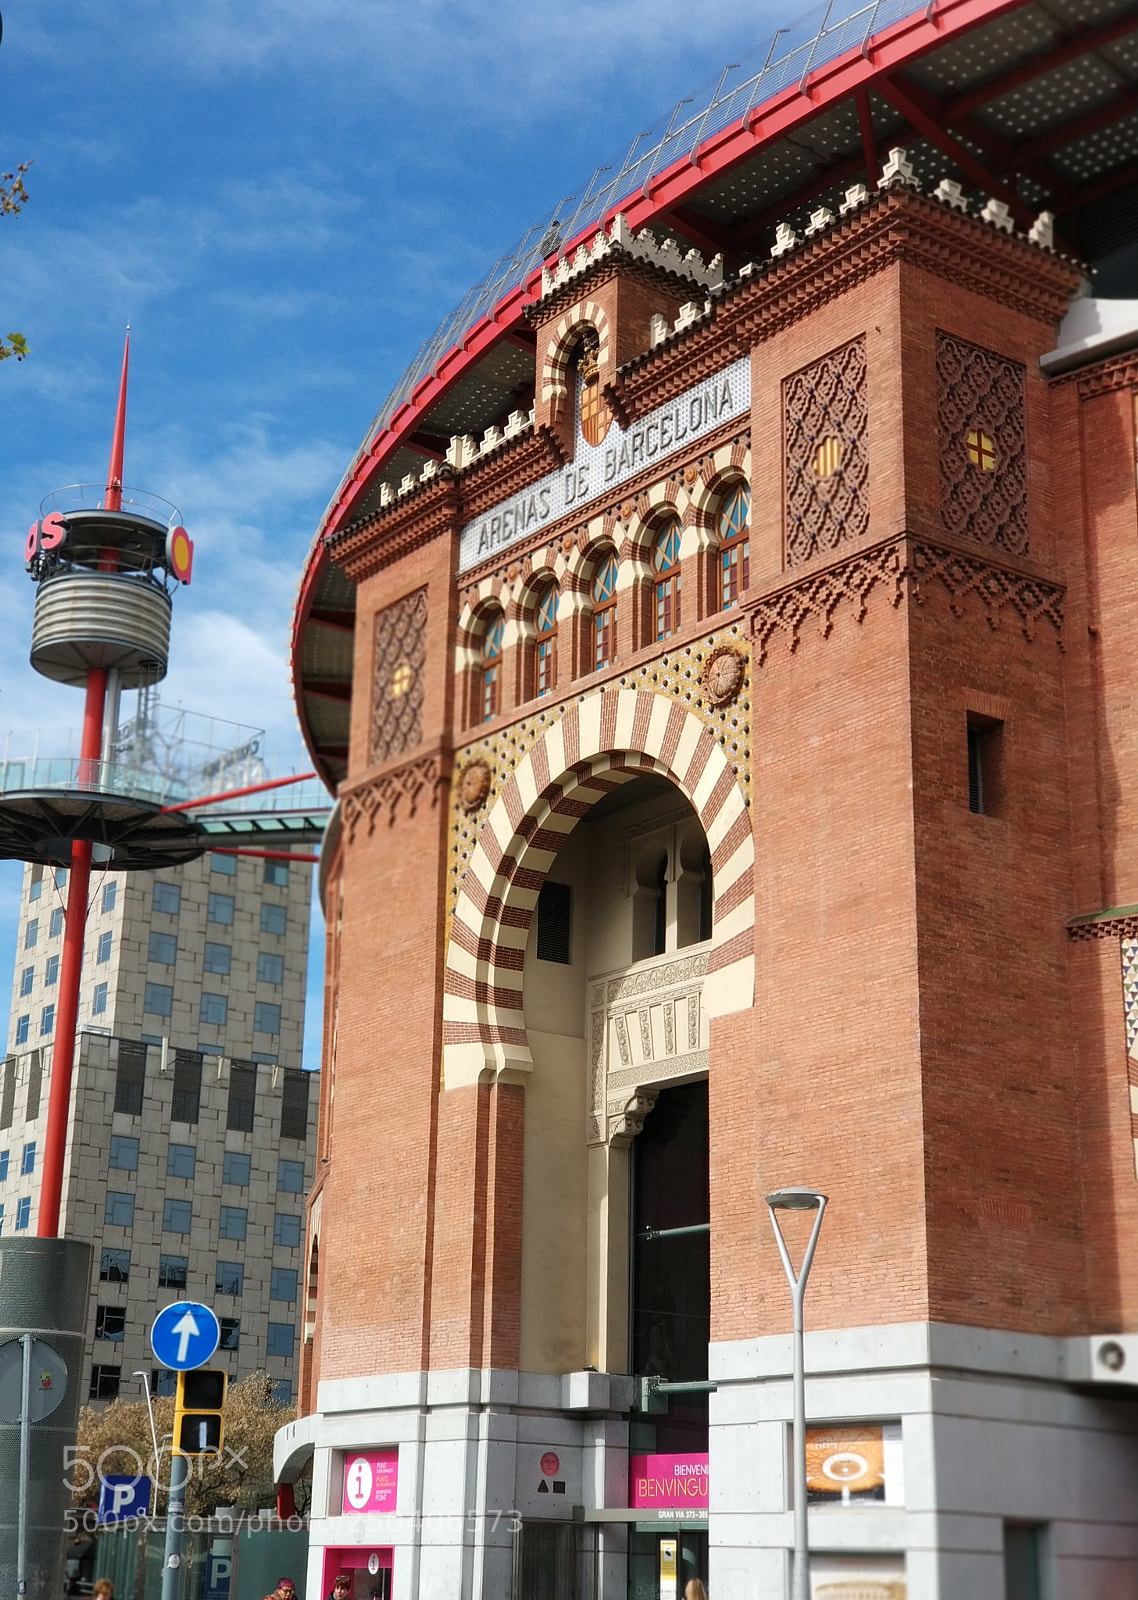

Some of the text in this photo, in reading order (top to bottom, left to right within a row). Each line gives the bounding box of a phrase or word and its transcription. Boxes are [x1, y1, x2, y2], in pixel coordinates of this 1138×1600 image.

[478, 379, 734, 554] ARENAS DE BARCELONA
[113, 1484, 135, 1513] P
[638, 1477, 709, 1497] BENVINGU
[657, 1510, 674, 1519] GRAN
[675, 1510, 685, 1518] VIA
[210, 1558, 231, 1588] P
